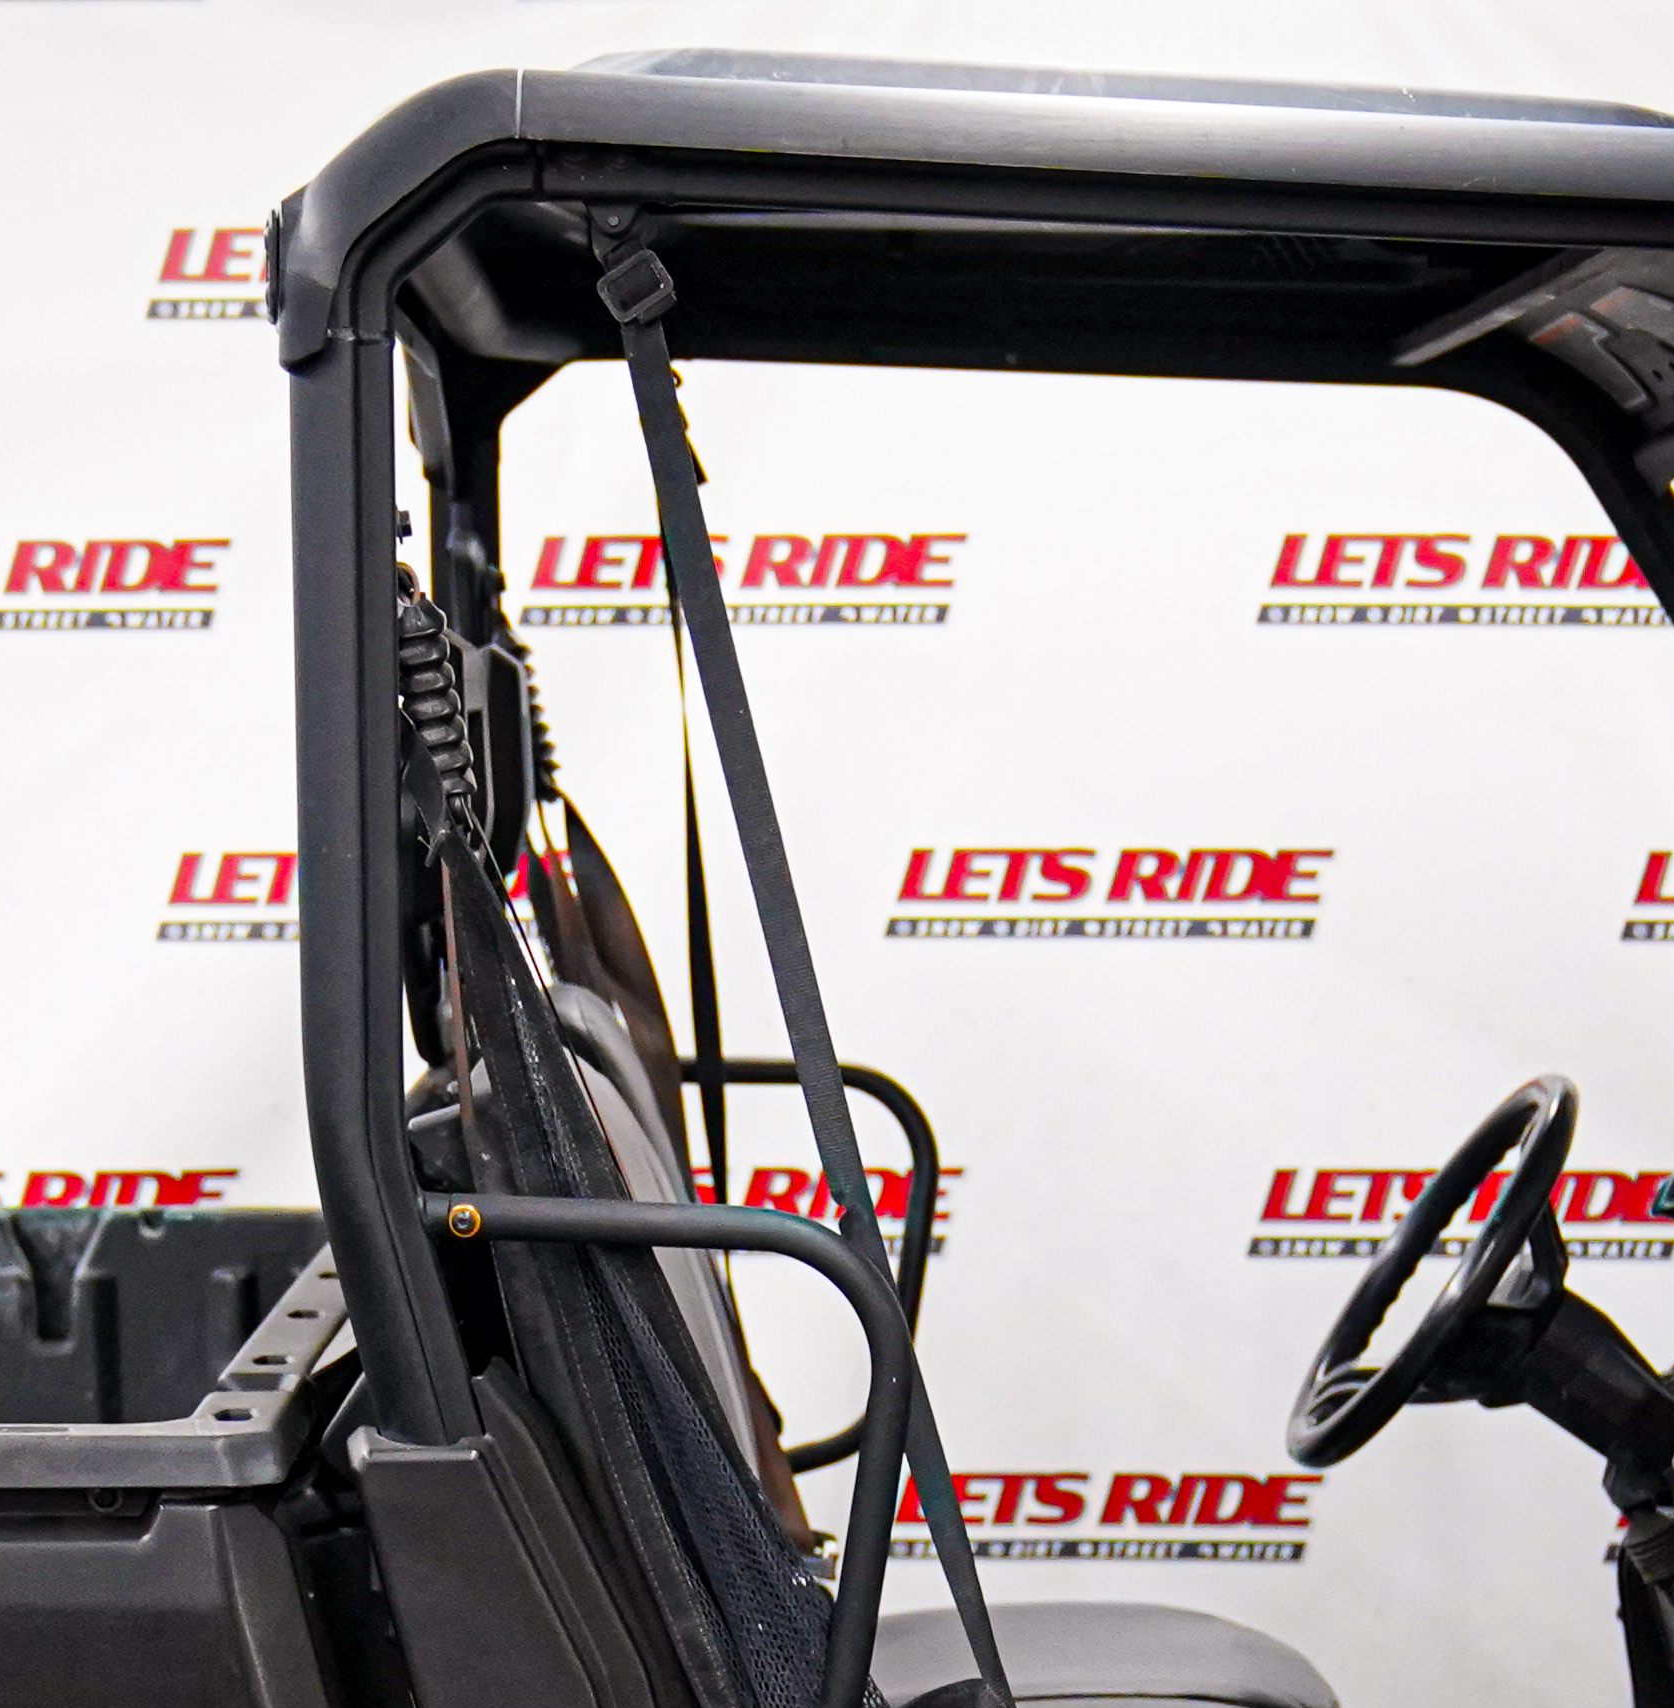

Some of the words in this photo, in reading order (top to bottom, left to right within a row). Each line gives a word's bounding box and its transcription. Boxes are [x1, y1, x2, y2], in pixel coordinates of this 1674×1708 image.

[158, 228, 265, 284] LE
[5, 539, 229, 595] RIDE
[530, 535, 728, 590] LET
[739, 534, 968, 590] RIDE
[1270, 533, 1470, 590] LETS
[168, 851, 299, 905] LET
[898, 847, 1097, 903] LETS
[1105, 847, 1335, 904] RIDE
[1260, 1168, 1436, 1222] LET
[1099, 1472, 1326, 1528] RIDE
